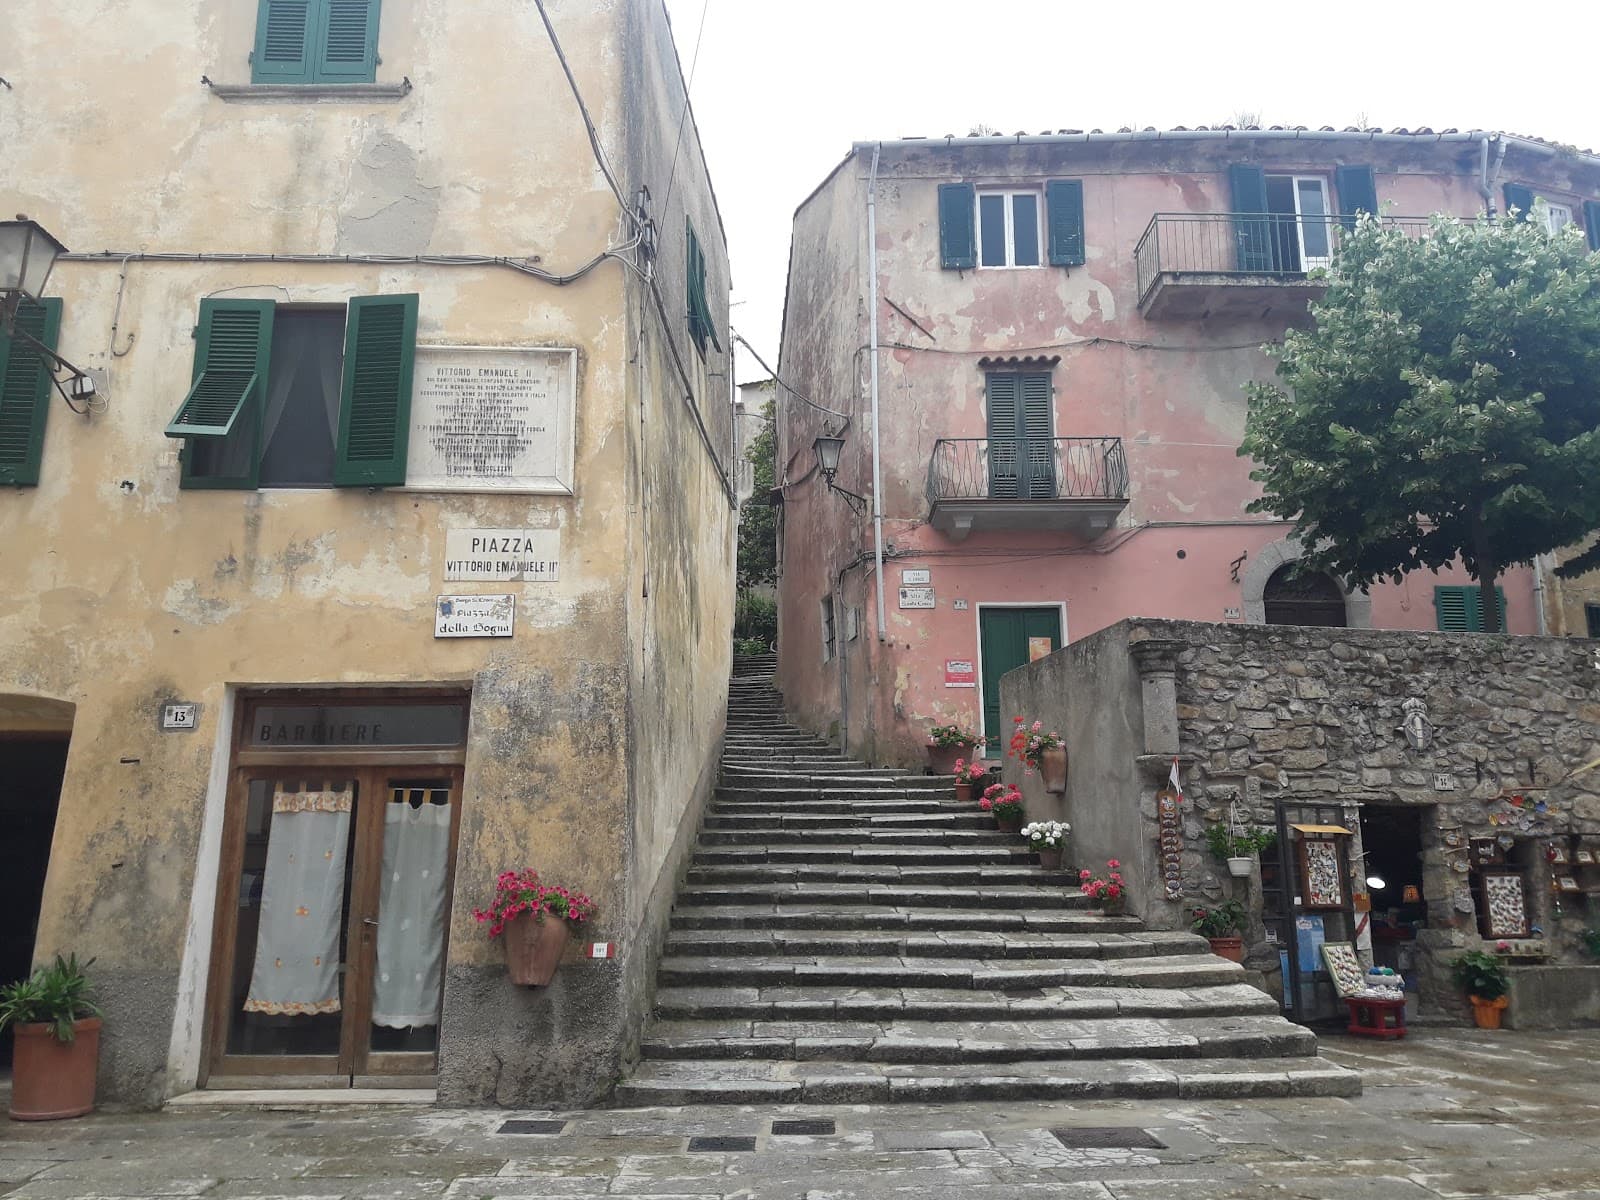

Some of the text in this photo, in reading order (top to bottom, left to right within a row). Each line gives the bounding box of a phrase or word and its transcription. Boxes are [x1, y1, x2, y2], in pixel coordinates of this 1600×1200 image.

[437, 368, 471, 376] VITTORIO
[478, 368, 519, 377] EMANUELE
[472, 538, 533, 553] PIAZZA
[447, 560, 492, 572] VITTORIO
[496, 561, 545, 573] EMANUELE
[456, 609, 490, 618] Piazza
[439, 623, 469, 633] della
[174, 711, 186, 722] 13
[260, 723, 382, 741] BARBIERE
